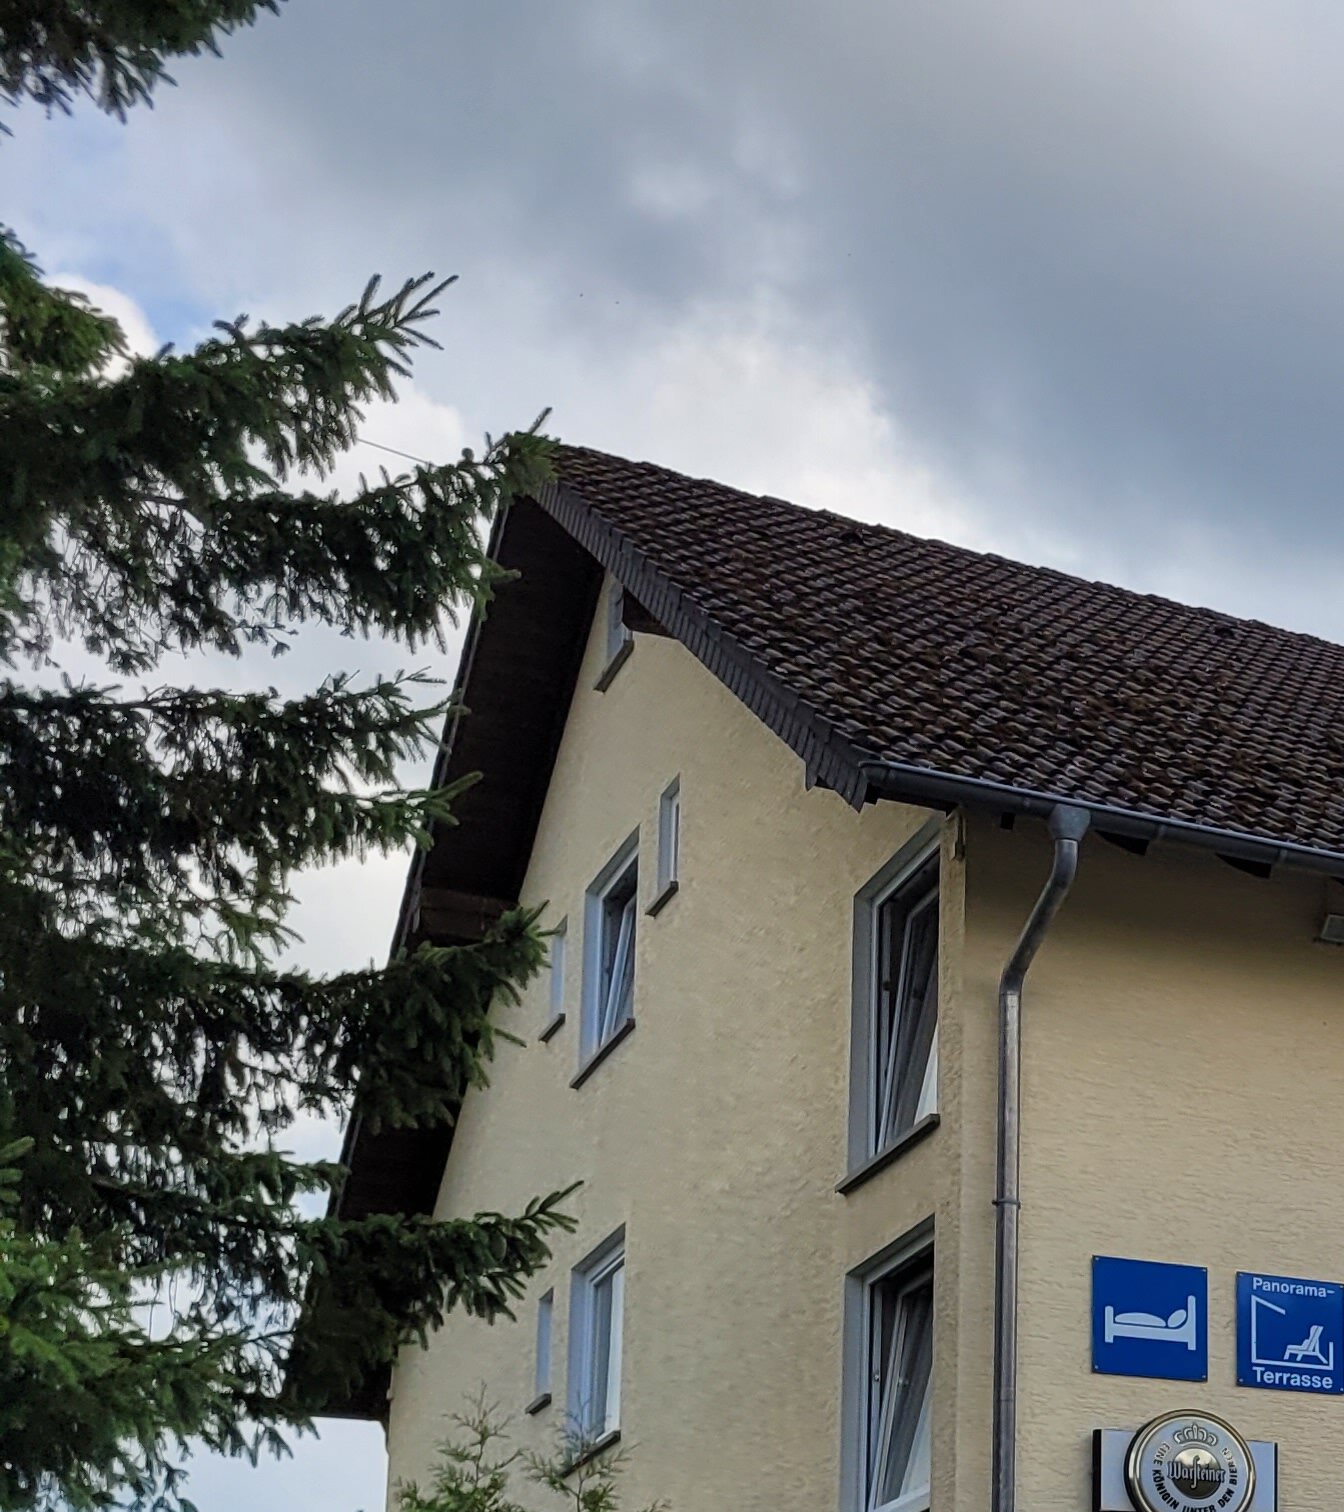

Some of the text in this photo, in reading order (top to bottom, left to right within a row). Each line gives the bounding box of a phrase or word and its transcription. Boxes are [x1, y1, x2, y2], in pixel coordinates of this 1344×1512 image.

[1252, 1277, 1335, 1298] Panorama-
[1252, 1366, 1333, 1389] Terrasse
[1217, 1488, 1235, 1508] DEN
